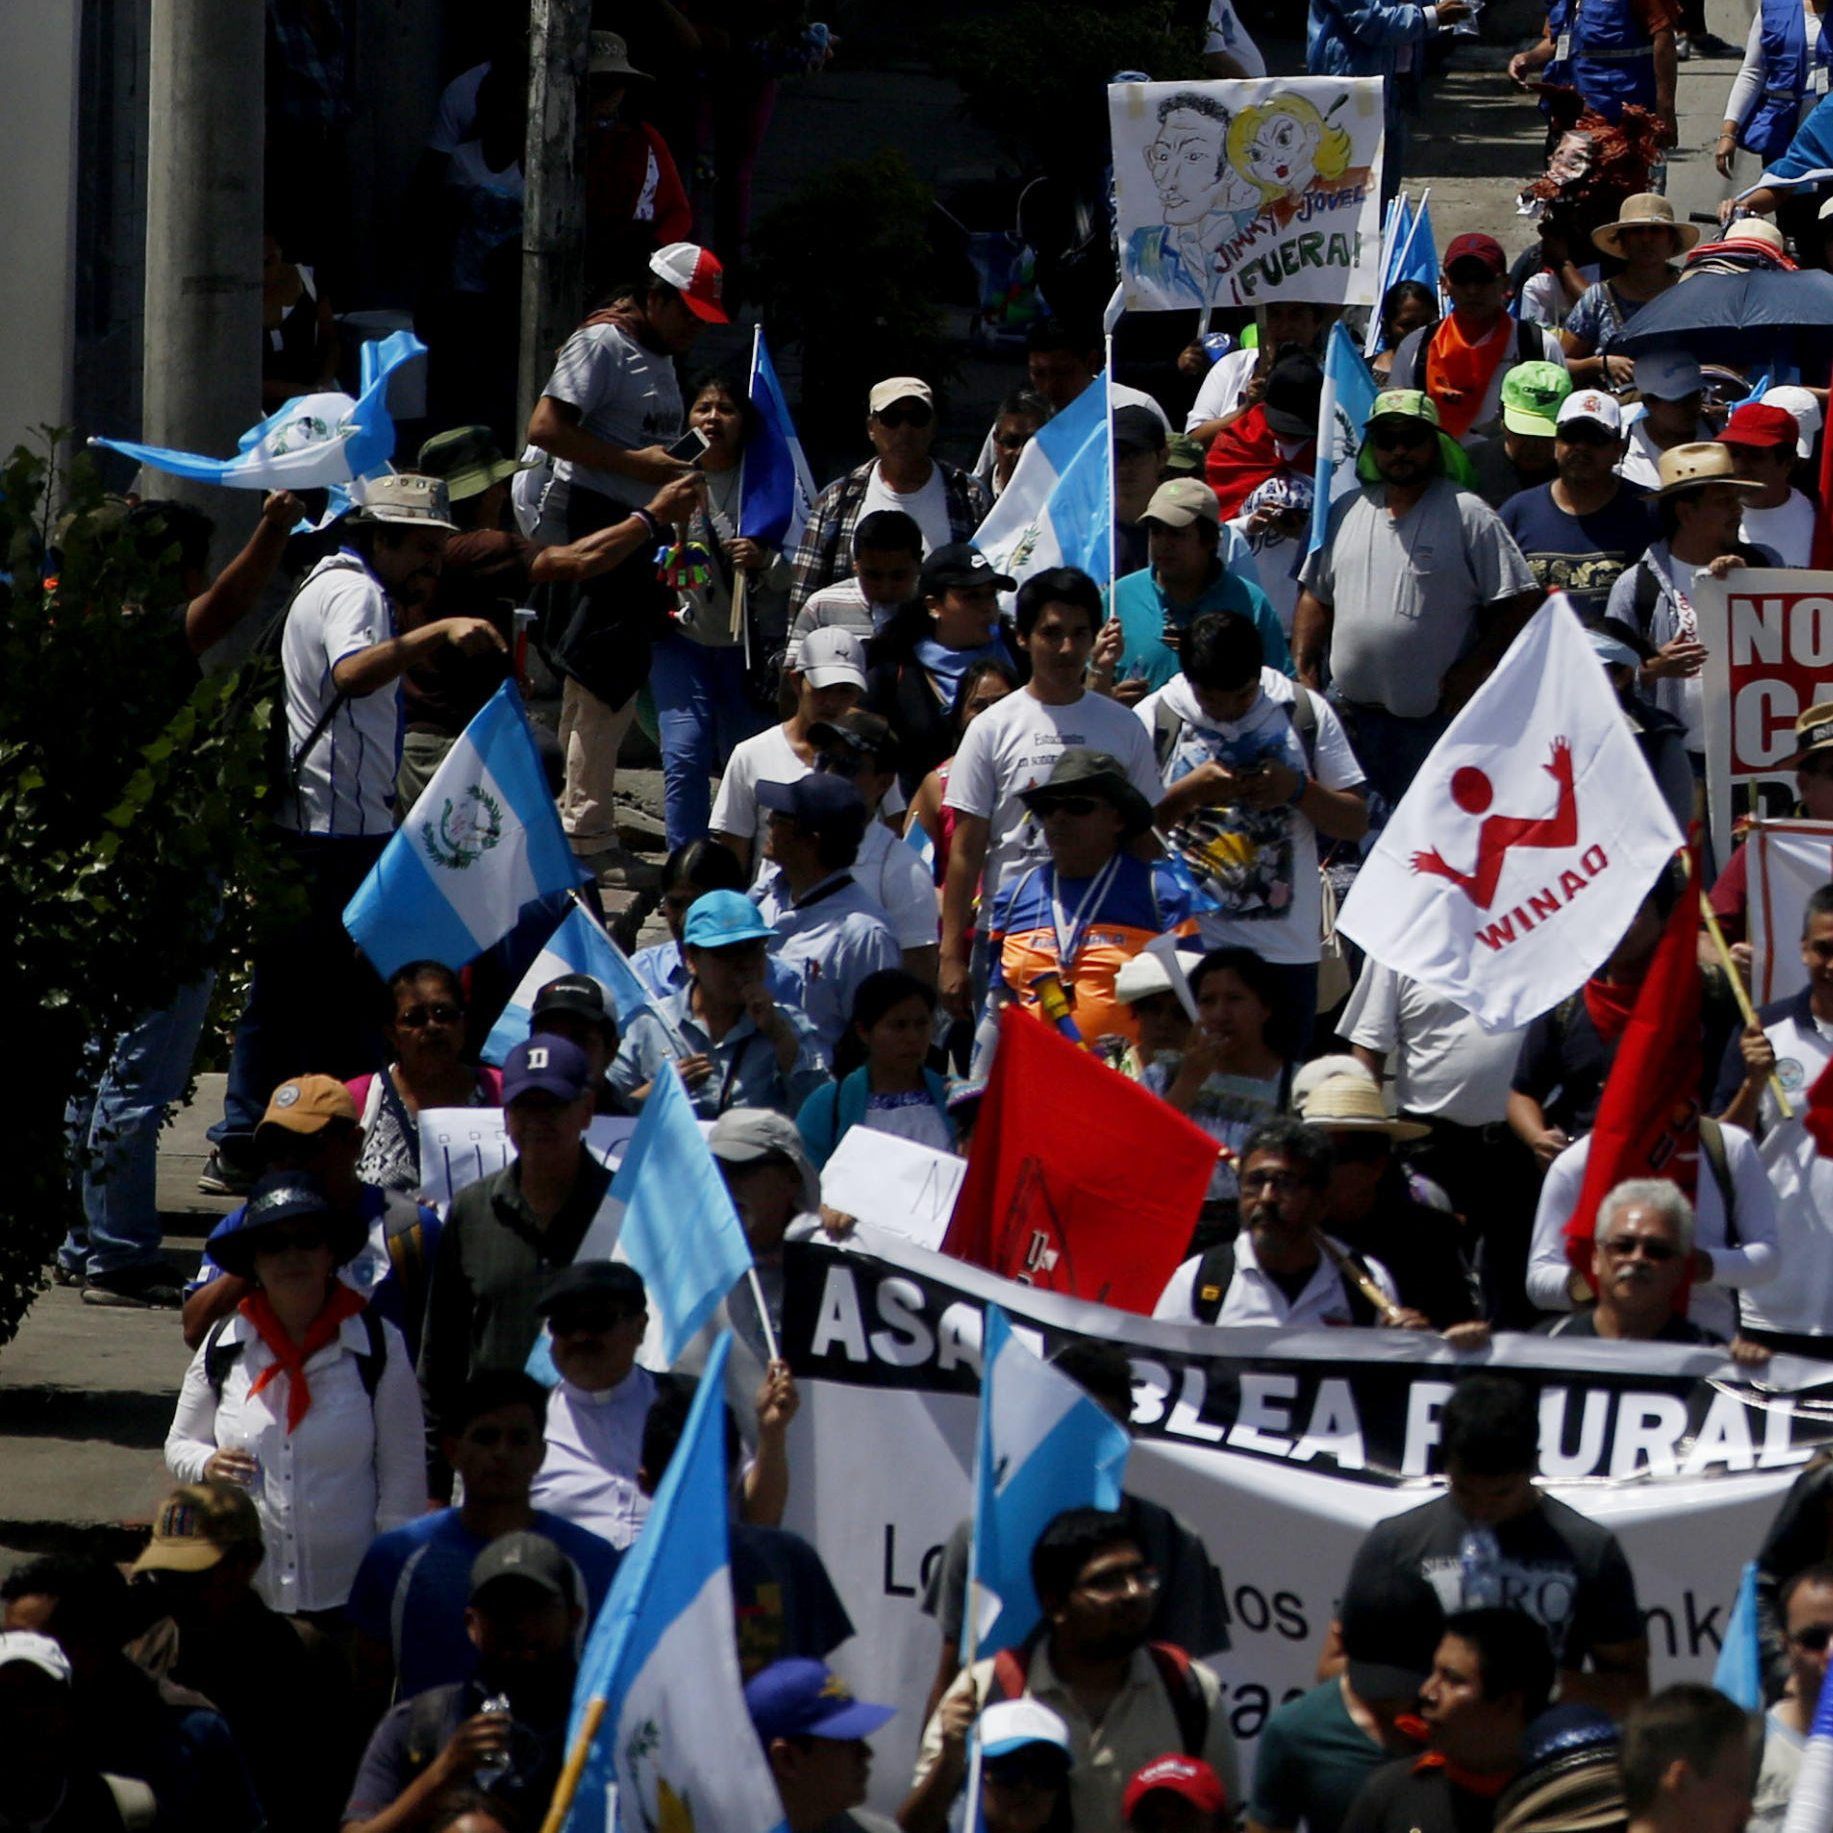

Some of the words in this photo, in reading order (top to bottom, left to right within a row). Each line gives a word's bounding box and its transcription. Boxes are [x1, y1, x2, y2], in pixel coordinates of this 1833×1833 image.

[1215, 209, 1278, 274] JIMMY
[1297, 184, 1367, 223] JOVEL
[811, 1264, 1366, 1470] ASABLEA
